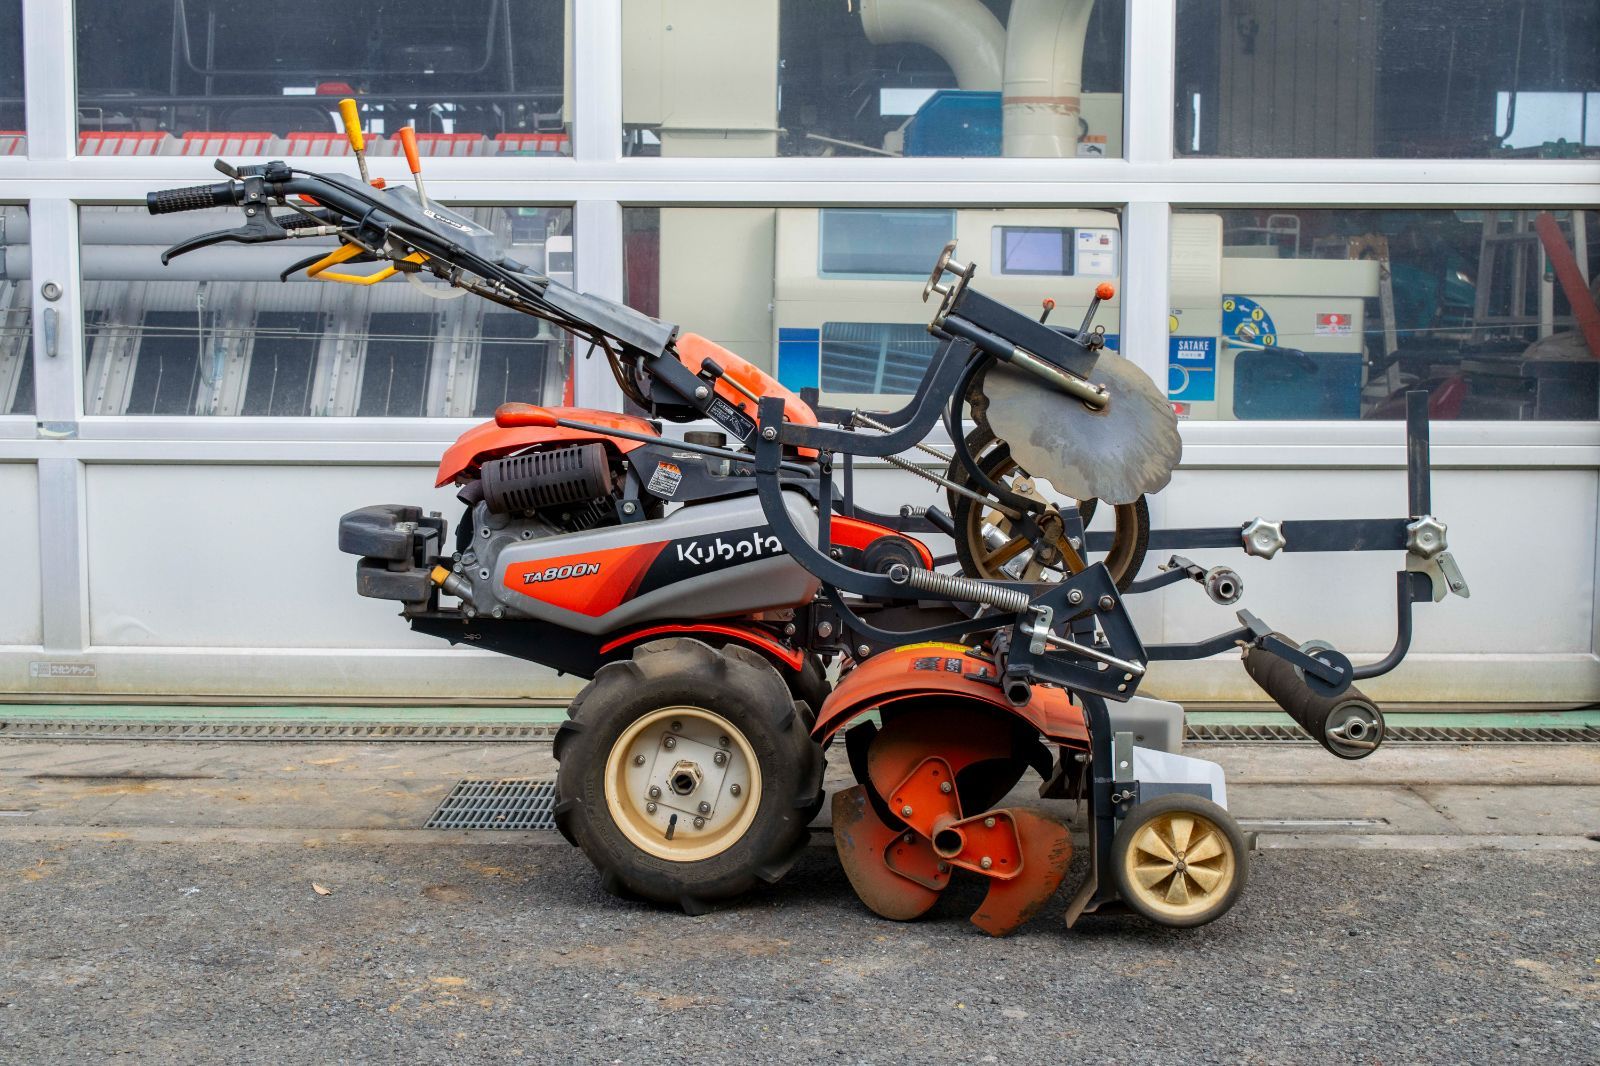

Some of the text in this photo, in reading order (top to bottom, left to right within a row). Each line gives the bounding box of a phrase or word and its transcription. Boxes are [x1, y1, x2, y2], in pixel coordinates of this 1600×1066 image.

[1225, 301, 1232, 311] 2
[1265, 335, 1272, 345] 0
[1178, 341, 1209, 351] SATAKE
[676, 532, 783, 565] Kubota
[523, 562, 601, 584] TA800N
